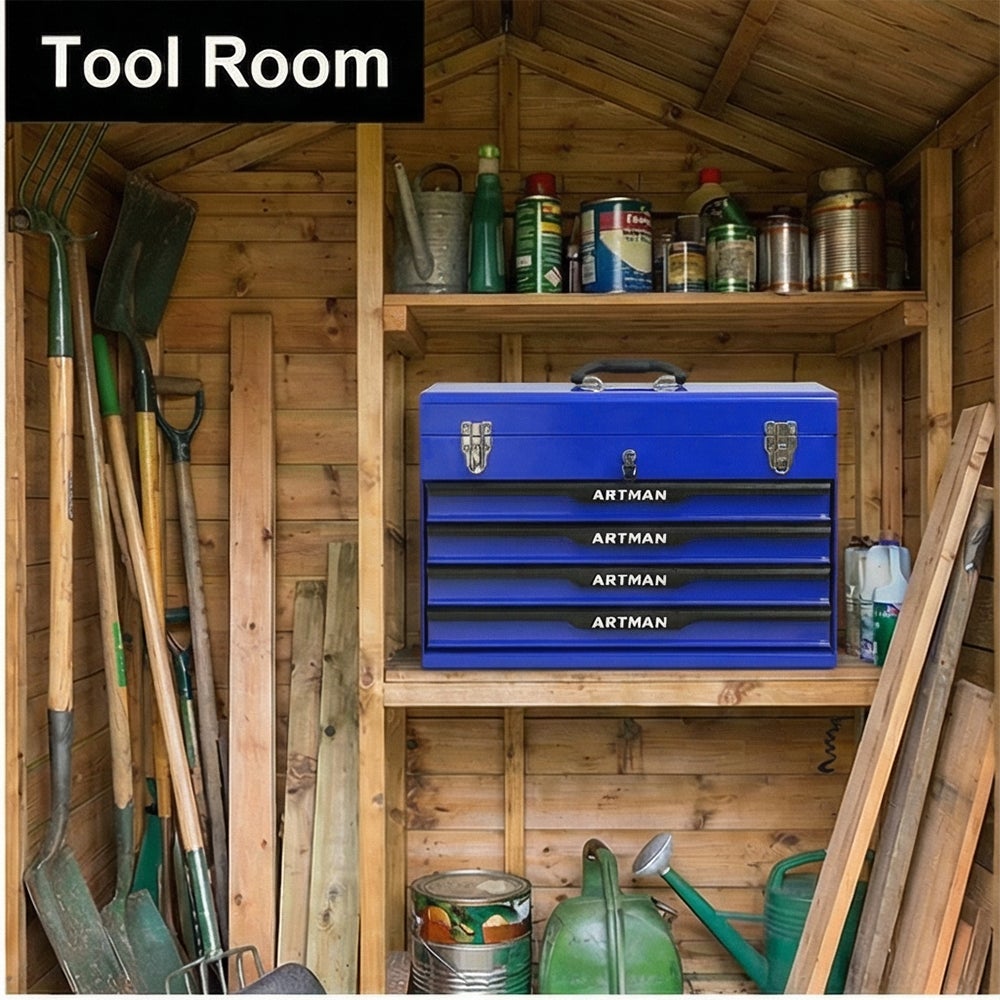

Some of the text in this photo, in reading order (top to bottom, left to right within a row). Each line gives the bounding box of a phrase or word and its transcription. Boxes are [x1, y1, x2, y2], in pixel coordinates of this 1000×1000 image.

[592, 489, 667, 501] ARTMAN
[592, 532, 667, 545] ARTMAN
[592, 573, 667, 586] ARTMAN
[592, 616, 667, 629] ARTMAN
